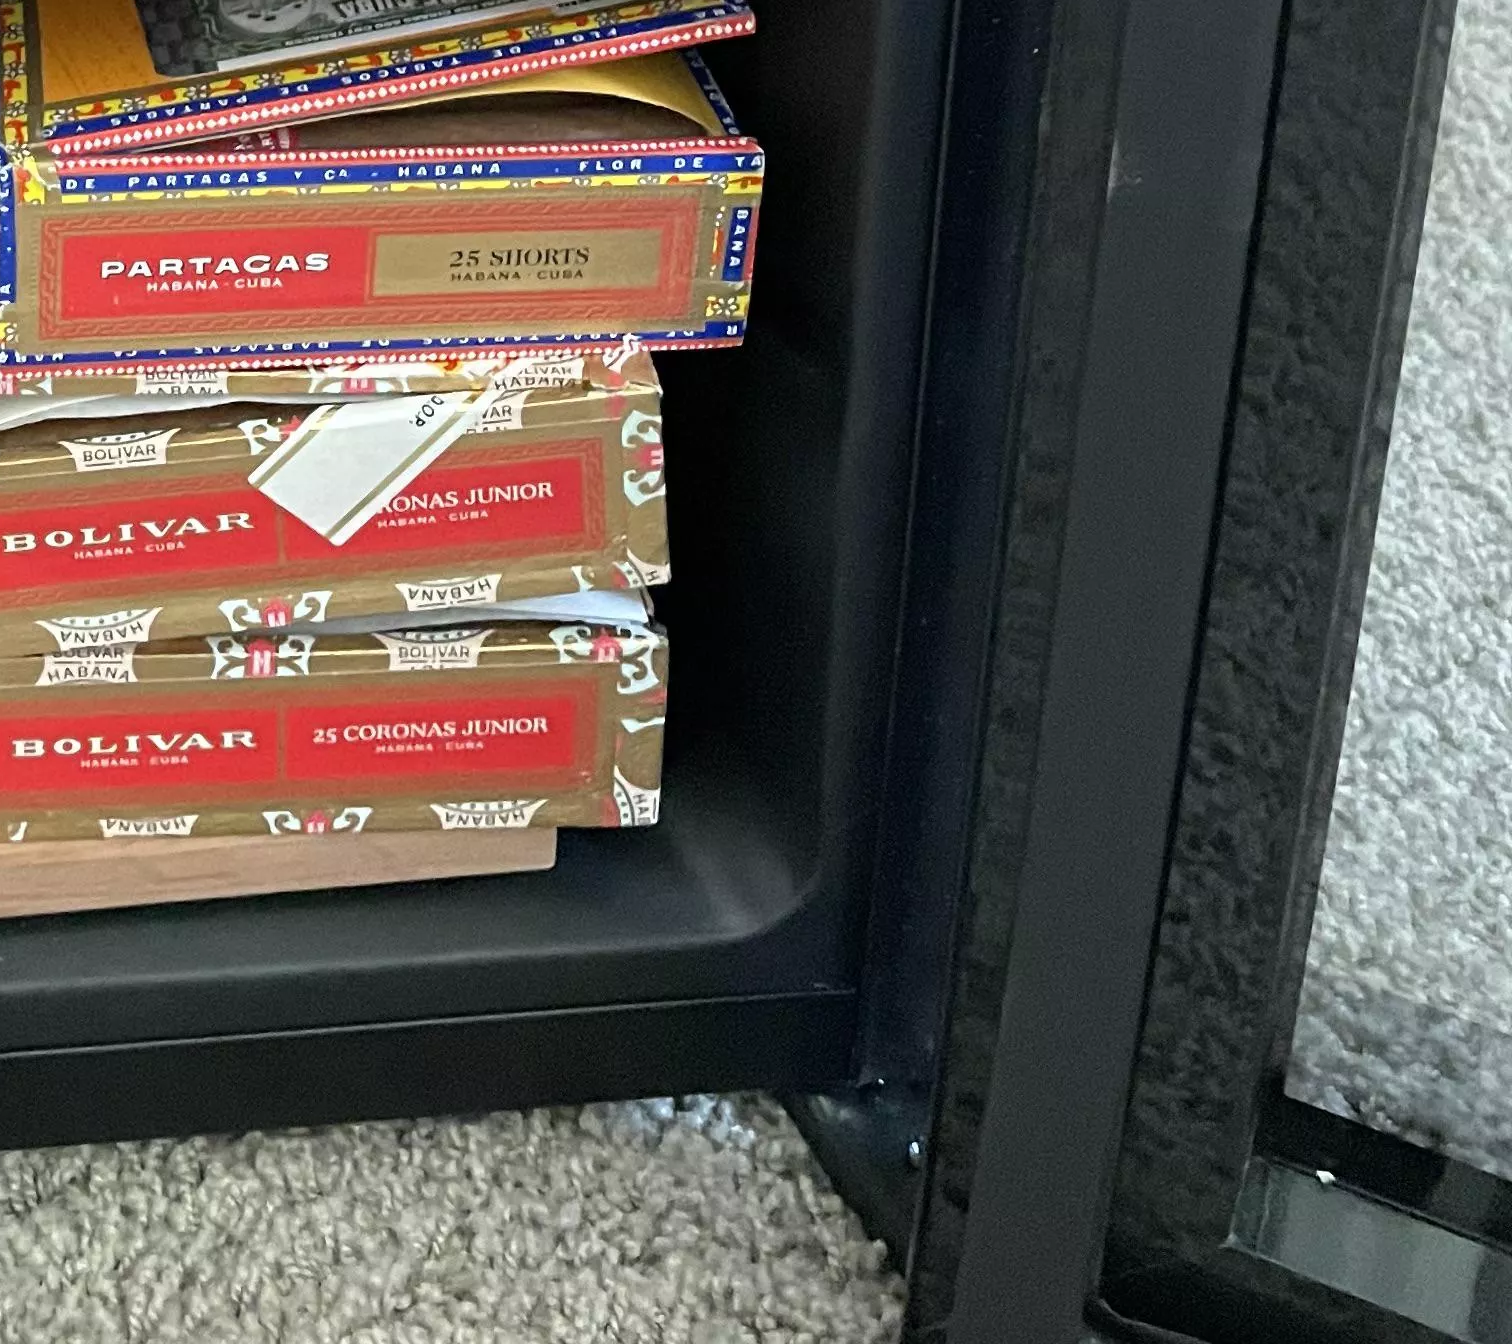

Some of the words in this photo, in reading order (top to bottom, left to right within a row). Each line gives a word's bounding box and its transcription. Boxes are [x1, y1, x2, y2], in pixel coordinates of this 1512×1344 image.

[554, 27, 617, 47] FLOR
[341, 56, 461, 85] TABACOS
[279, 83, 308, 96] DE
[109, 94, 248, 126] PARTAGAS
[65, 177, 95, 190] DE
[128, 171, 268, 189] PARTAGAS
[294, 170, 303, 179] Y
[324, 169, 348, 181] CA
[398, 162, 502, 178] HABANA
[579, 159, 643, 172] FLOR
[674, 156, 704, 169] DE
[101, 253, 330, 279] PARTAGAS
[449, 250, 481, 268] 25
[490, 247, 590, 268] SHORTS
[146, 279, 219, 292] HABANA
[234, 277, 284, 289] CUBA
[451, 270, 521, 282] HABANA
[537, 269, 584, 280] CUBA
[83, 443, 157, 462] BOLIVAR
[465, 481, 554, 506] JUNIOR
[378, 515, 436, 529] HABANA
[449, 510, 488, 522] CUBA
[2, 512, 254, 553] BOLIVAR
[74, 546, 133, 560] HABANA
[144, 541, 185, 553] CUBA
[408, 578, 492, 602] HABANA
[60, 622, 144, 643] HABANA
[398, 645, 471, 660] BOLIVAR
[47, 665, 130, 683] HABANA
[312, 729, 337, 744] 25
[343, 722, 456, 742] CORONAS
[462, 717, 549, 737] JUNIOR
[11, 730, 256, 758] BOLIVAR
[80, 758, 139, 769] HABANA
